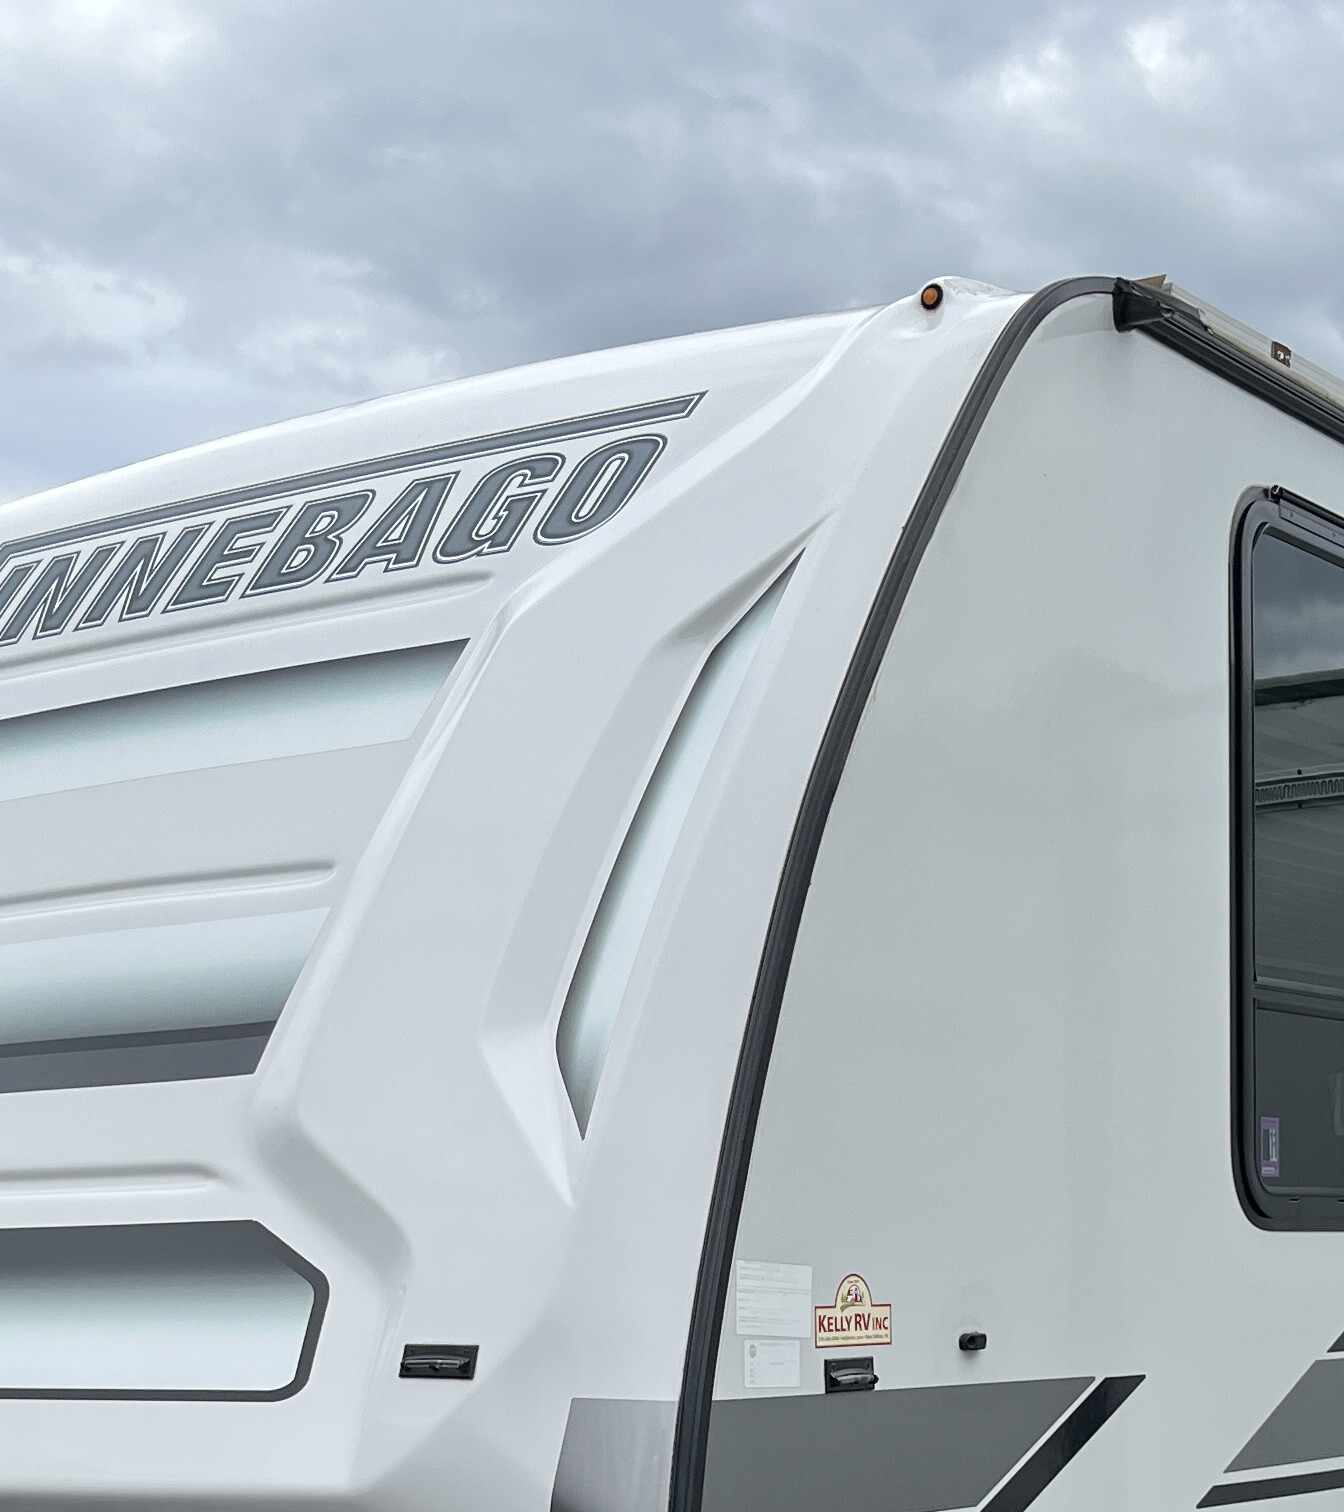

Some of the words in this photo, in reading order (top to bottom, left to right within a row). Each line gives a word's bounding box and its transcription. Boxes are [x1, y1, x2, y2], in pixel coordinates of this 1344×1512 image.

[818, 1314, 853, 1333] KELLY
[854, 1312, 871, 1331] RV
[872, 1316, 889, 1331] INC
